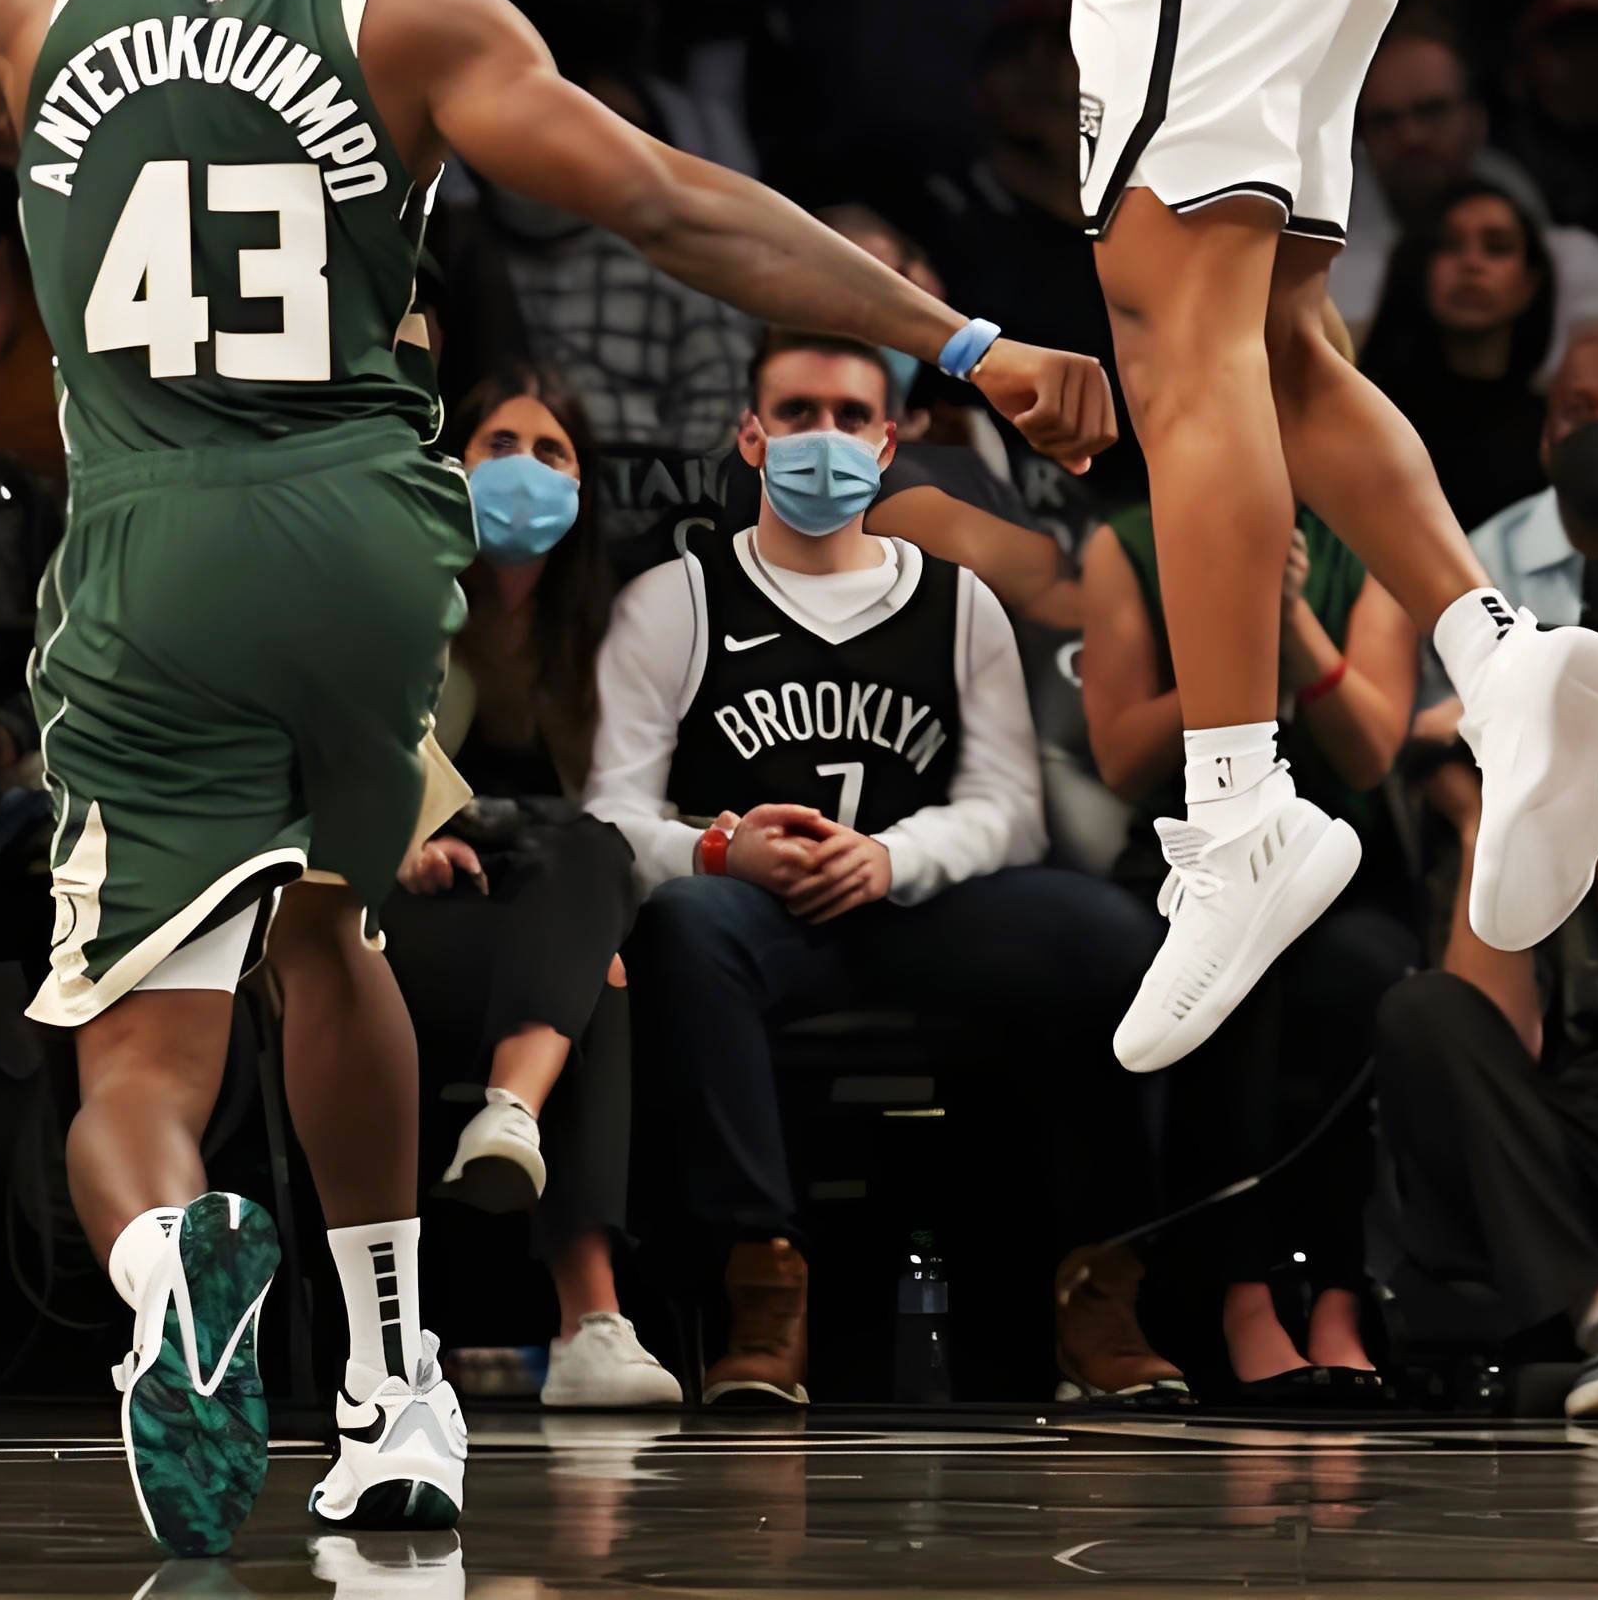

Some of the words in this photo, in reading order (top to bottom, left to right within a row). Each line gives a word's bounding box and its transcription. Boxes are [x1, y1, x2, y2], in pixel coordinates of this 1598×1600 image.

[30, 15, 389, 203] ANTETOKOUNMPO
[84, 160, 332, 383] 43
[713, 680, 948, 776] BROOKLYN
[815, 761, 865, 831] 7
